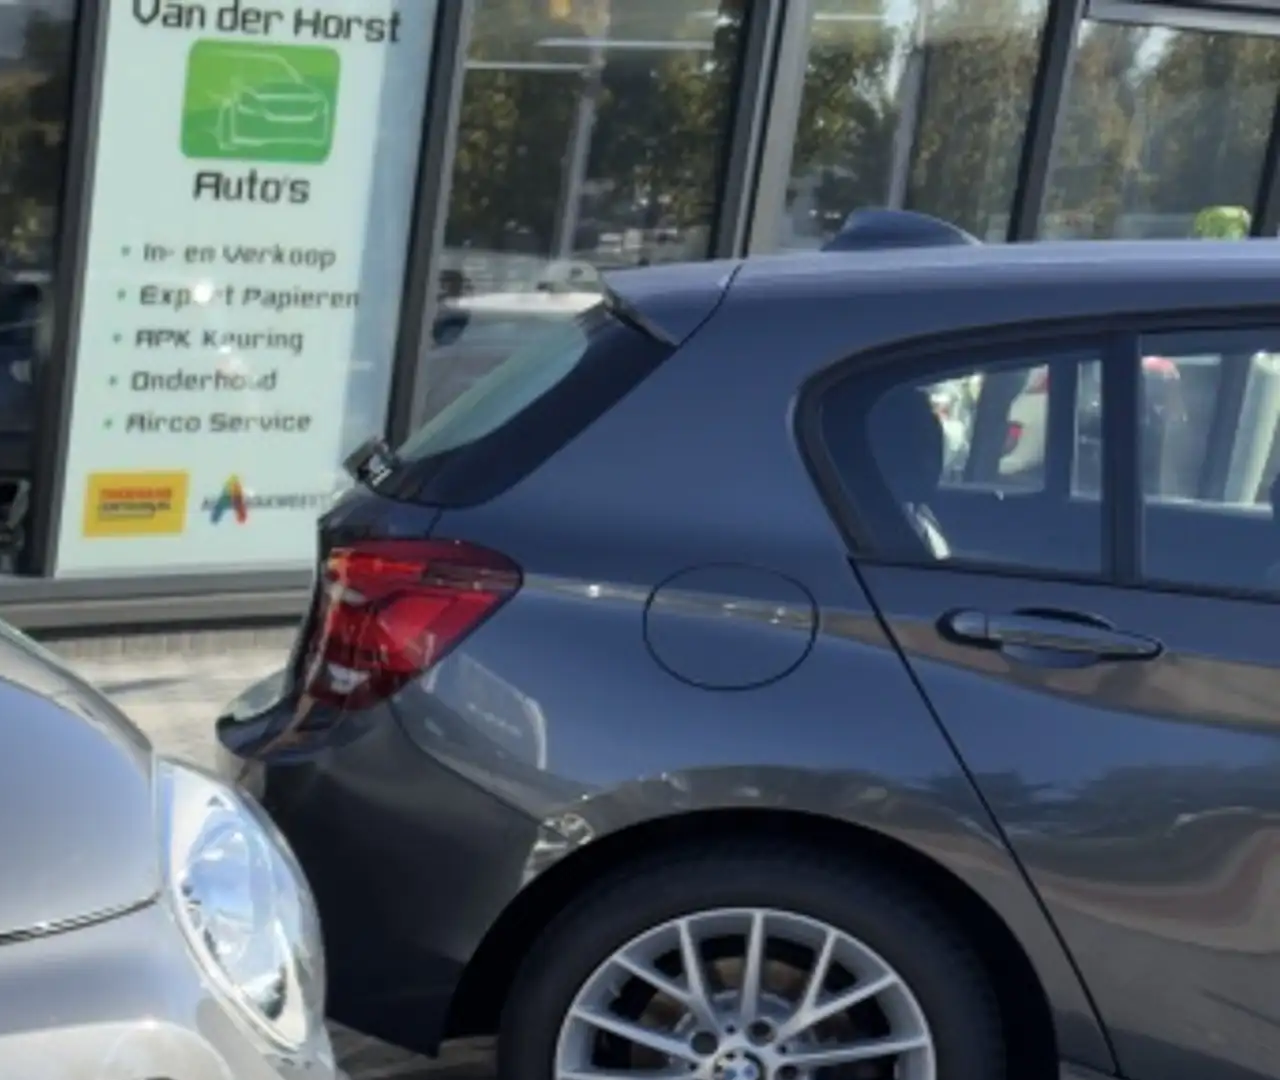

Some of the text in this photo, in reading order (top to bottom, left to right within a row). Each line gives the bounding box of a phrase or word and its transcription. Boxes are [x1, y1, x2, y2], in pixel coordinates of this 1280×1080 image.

[132, 0, 401, 42] Van der Horst
[193, 169, 310, 204] Auto's
[142, 243, 337, 272] In- en Verkoop
[241, 286, 360, 314] Papieren
[135, 328, 192, 350] APK
[130, 368, 278, 392] Onderhod
[125, 411, 313, 435] Airco Service
